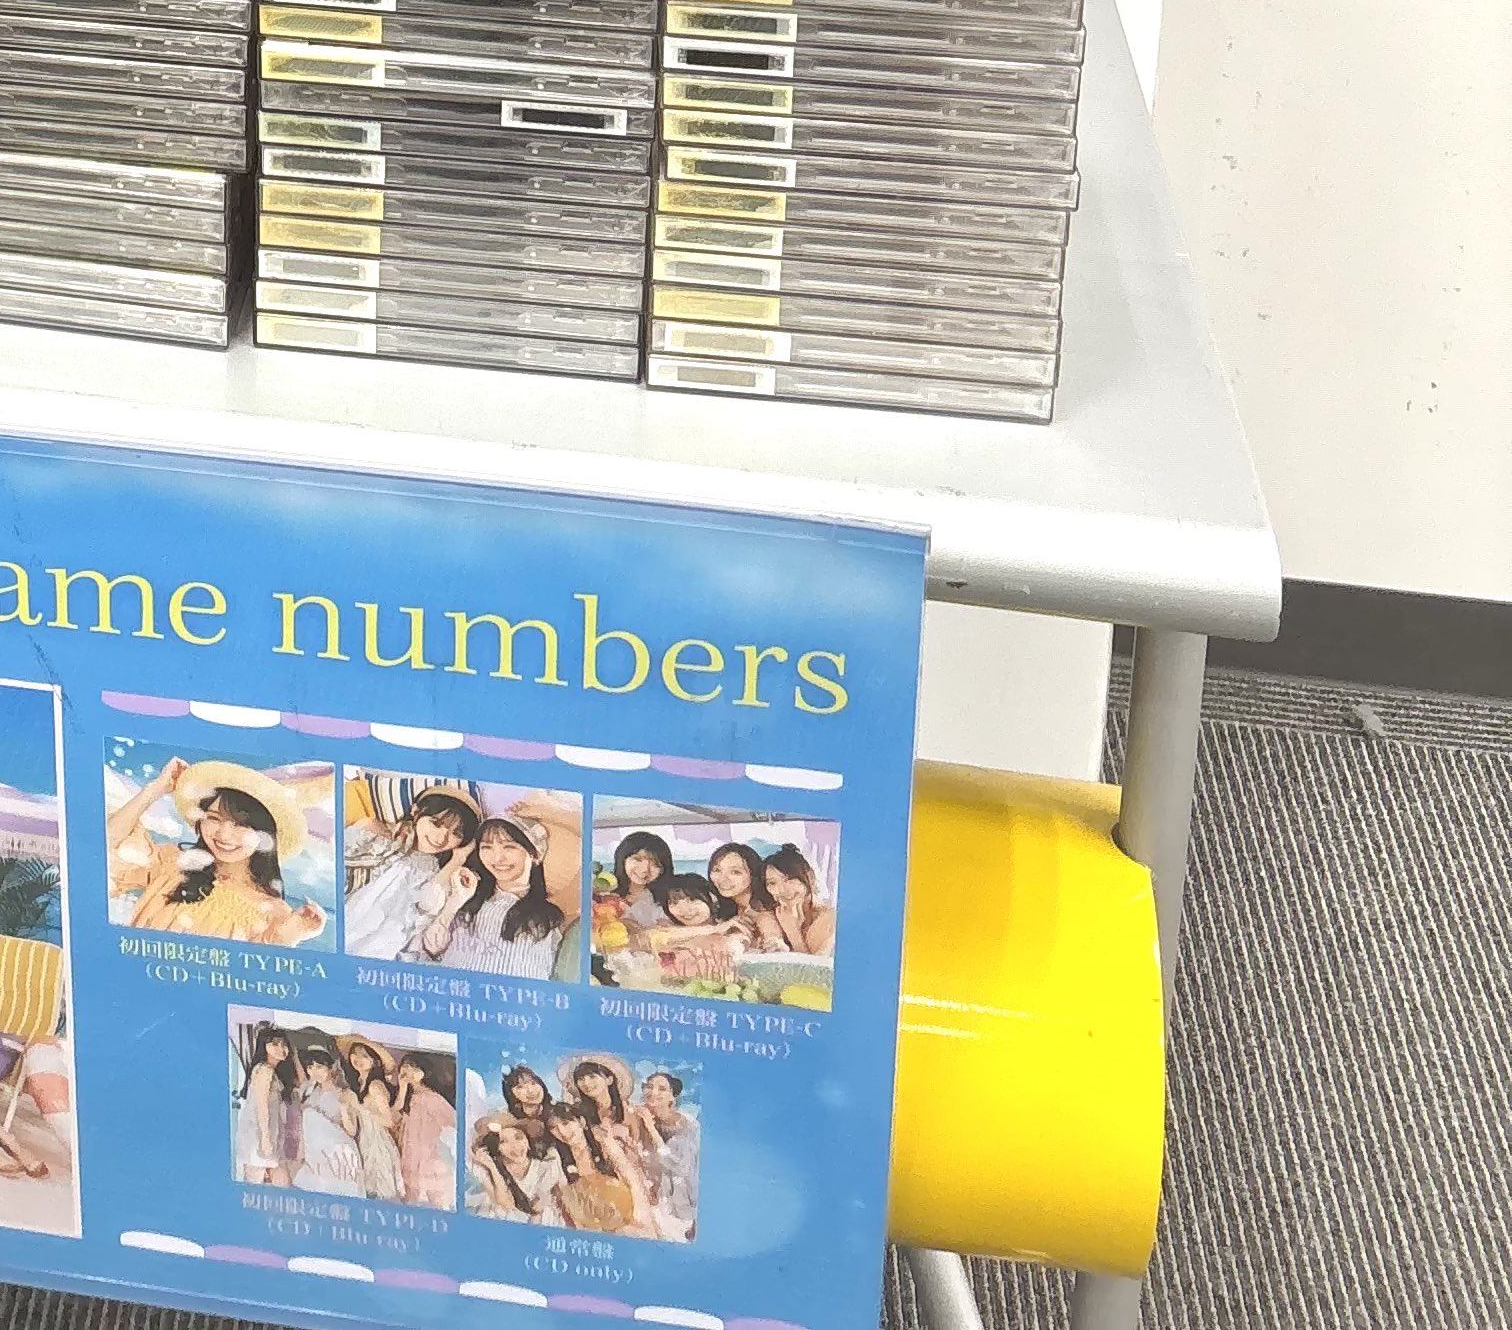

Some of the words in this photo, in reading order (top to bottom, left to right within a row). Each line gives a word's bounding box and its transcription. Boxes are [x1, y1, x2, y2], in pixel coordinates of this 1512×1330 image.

[271, 594, 851, 716] numbers
[118, 936, 231, 969] 初回限定盤
[236, 951, 328, 980] TYPE-A
